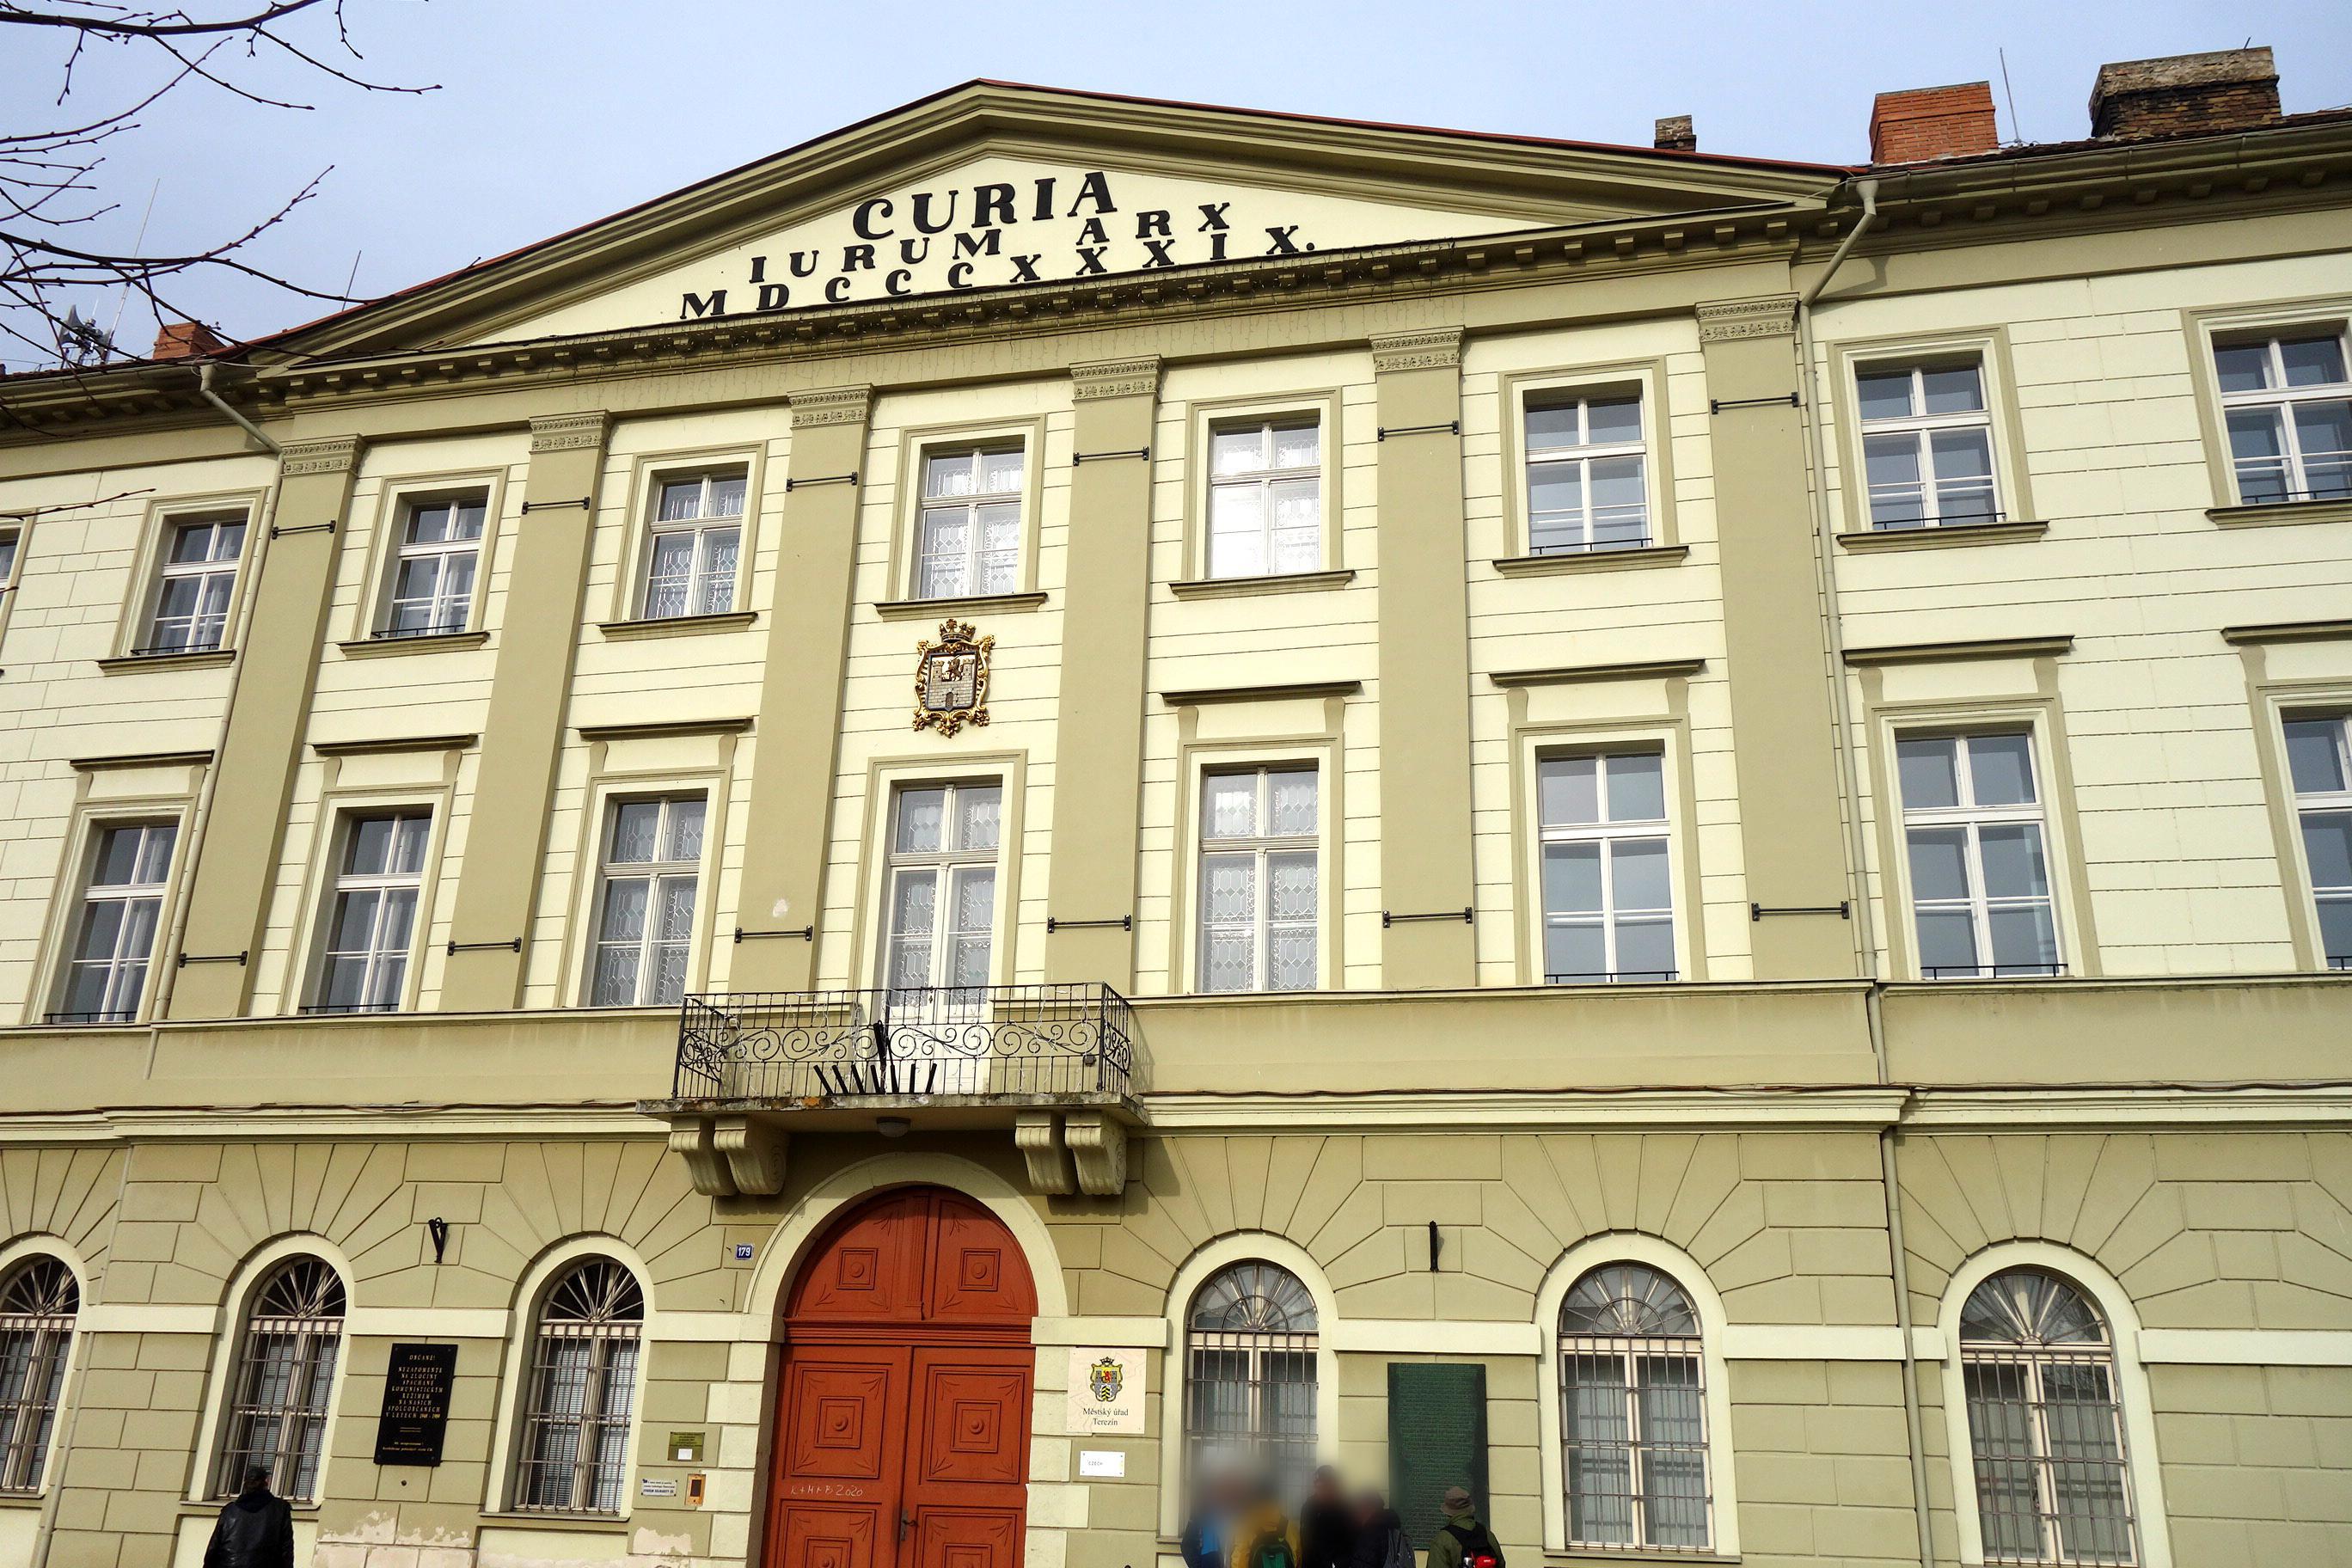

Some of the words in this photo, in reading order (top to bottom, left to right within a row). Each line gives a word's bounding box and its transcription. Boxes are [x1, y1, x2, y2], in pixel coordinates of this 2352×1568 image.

[852, 171, 1118, 240] CURIA
[749, 228, 1002, 284] IURUM
[1076, 201, 1231, 247] ARX
[738, 1246, 750, 1257] 179
[1083, 1407, 1112, 1418] Městský
[1113, 1408, 1129, 1417] úřad
[1093, 1418, 1118, 1426] Terezín
[836, 1485, 863, 1497] 2020
